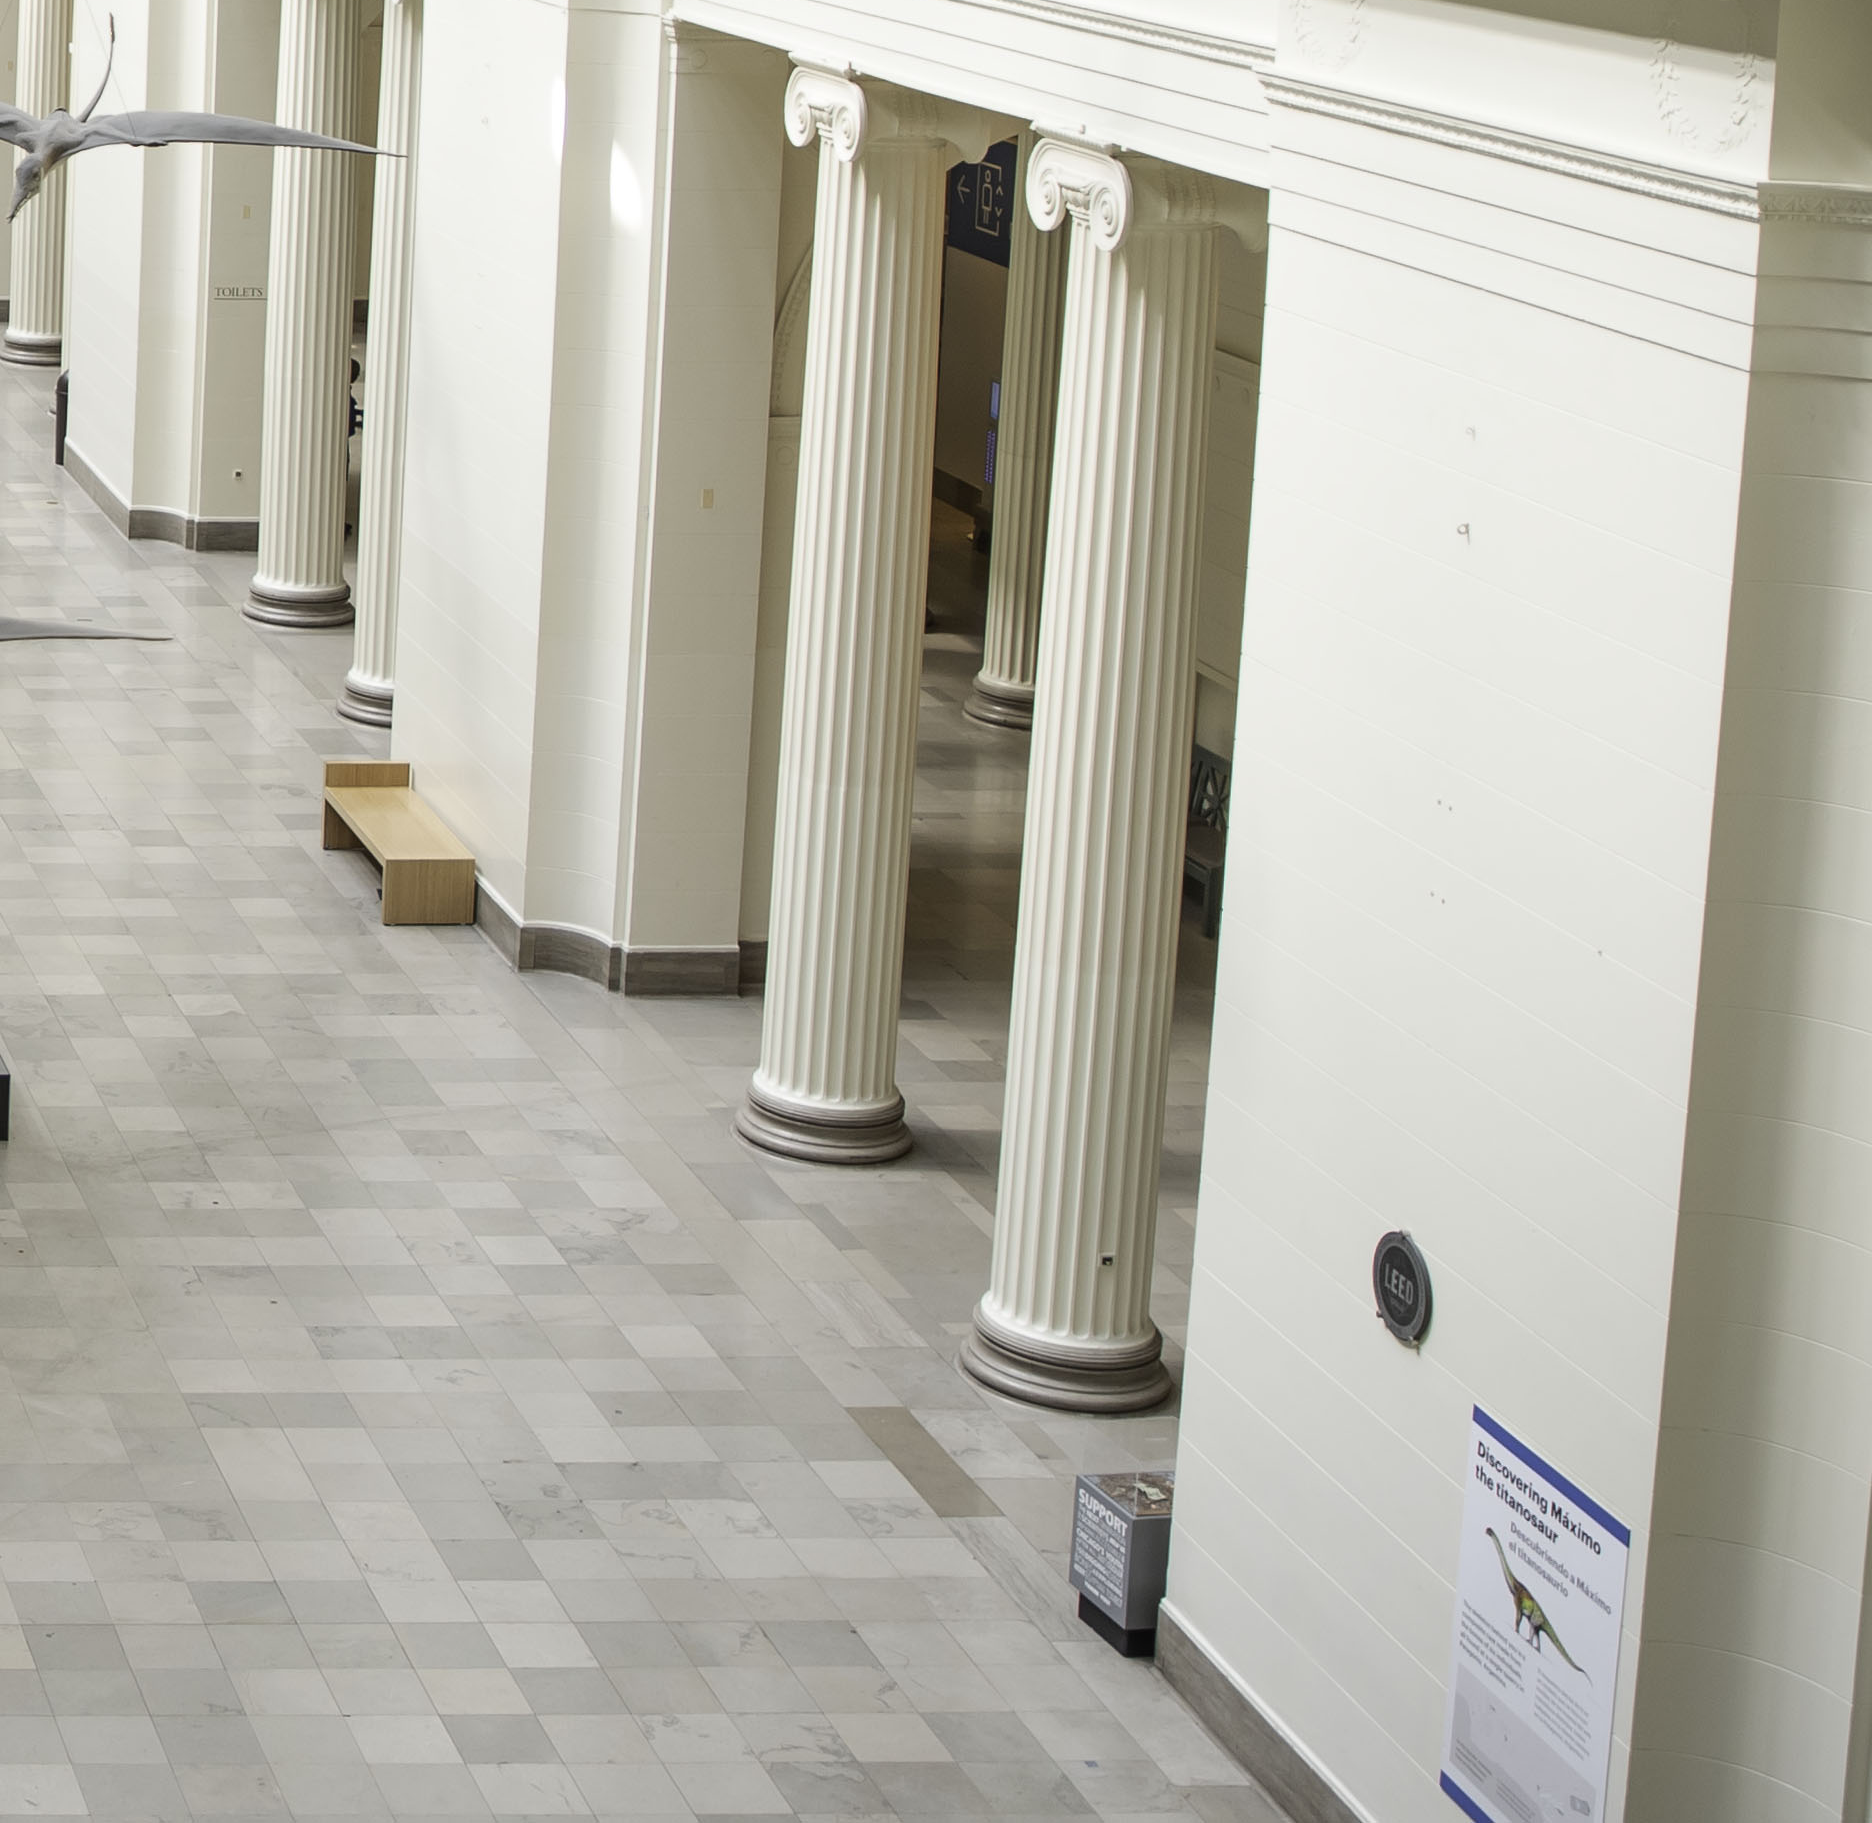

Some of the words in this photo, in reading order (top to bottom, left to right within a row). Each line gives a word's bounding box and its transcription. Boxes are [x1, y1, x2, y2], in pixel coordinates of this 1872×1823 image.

[214, 287, 264, 297] TOILETS
[1385, 1262, 1414, 1306] LEED
[1078, 1488, 1128, 1537] SUPPORT
[1475, 1465, 1494, 1491] the
[1496, 1482, 1559, 1544] titanosaur
[1477, 1440, 1548, 1514] Discovering
[1551, 1501, 1602, 1555] Máximo
[1508, 1540, 1517, 1554] el
[1517, 1546, 1569, 1598] titanosaurio
[1510, 1522, 1569, 1579] Descubriendo
[1569, 1574, 1575, 1584] a
[1576, 1578, 1612, 1616] Máximo
